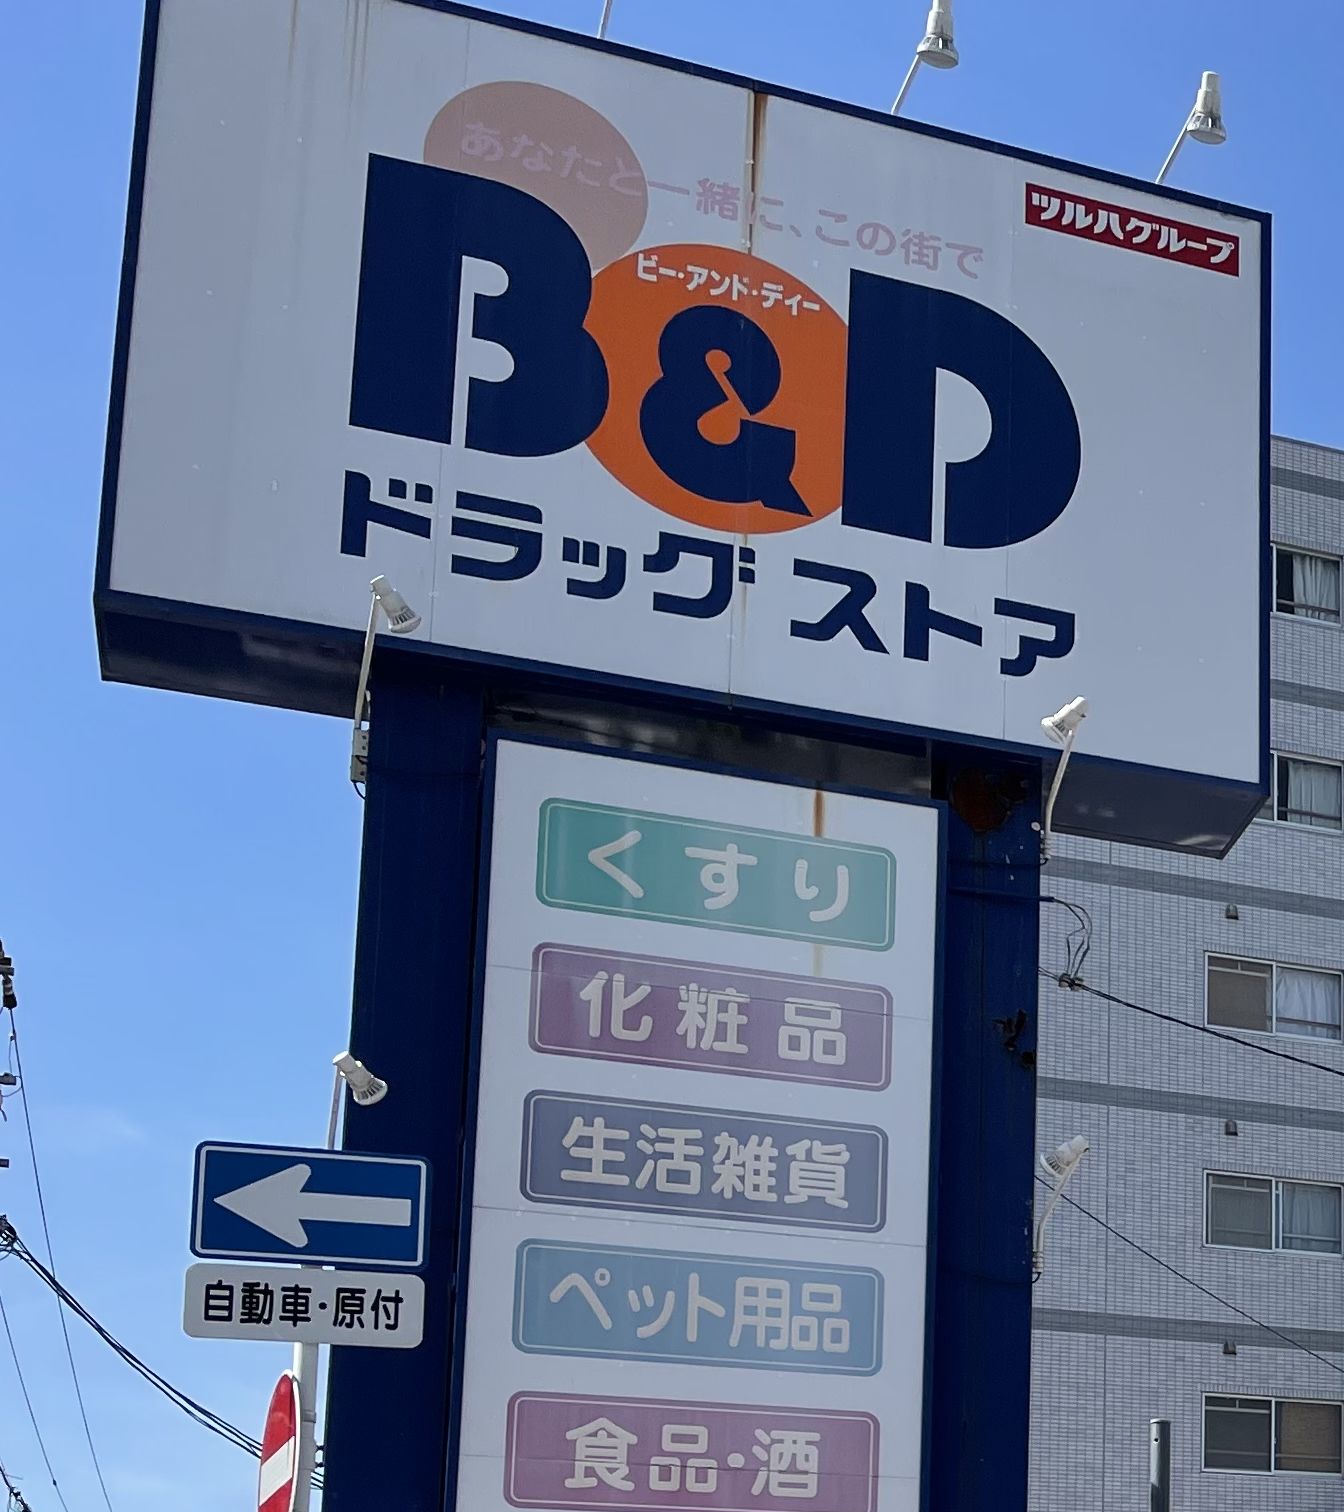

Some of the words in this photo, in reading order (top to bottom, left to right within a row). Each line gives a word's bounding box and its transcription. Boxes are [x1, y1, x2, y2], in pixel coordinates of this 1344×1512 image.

[459, 119, 984, 279] あなたと一緒に、この街で
[1031, 186, 1236, 268] ツルハグループ
[349, 152, 1082, 550] B&D
[588, 830, 849, 922] くすり
[579, 970, 847, 1066] 化粧品
[560, 1116, 850, 1209] 生活雑貨
[204, 1280, 403, 1330] 自動車・原付
[549, 1267, 850, 1354] ペット用品
[564, 1416, 821, 1499] 食品・酒
